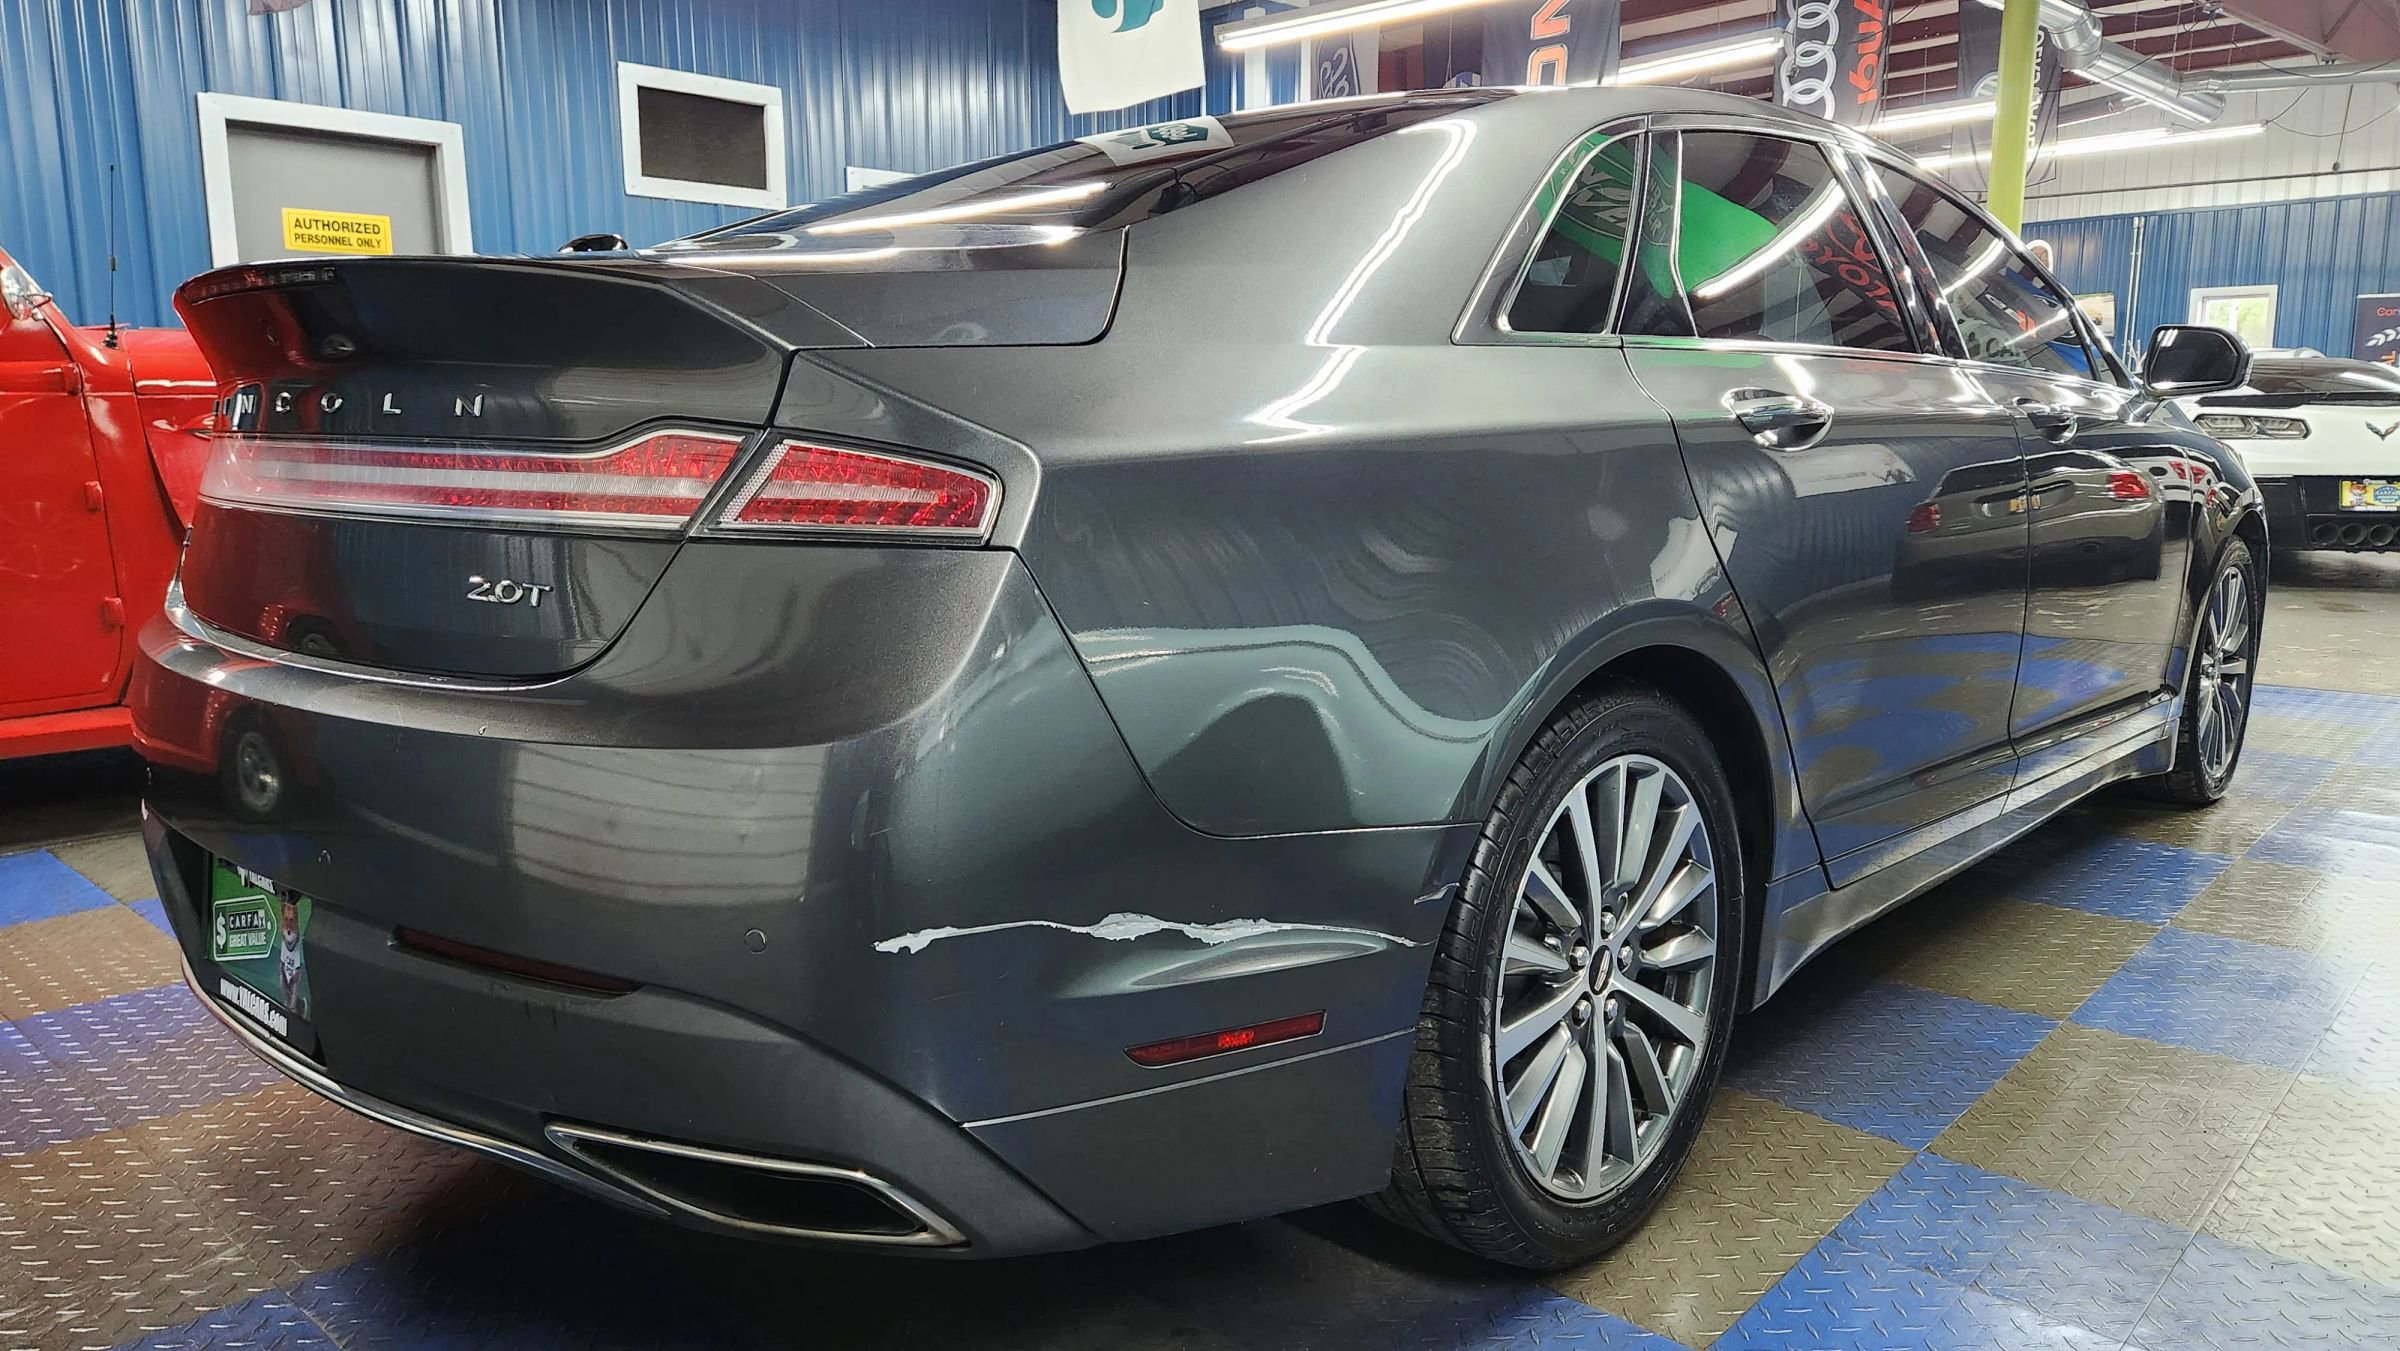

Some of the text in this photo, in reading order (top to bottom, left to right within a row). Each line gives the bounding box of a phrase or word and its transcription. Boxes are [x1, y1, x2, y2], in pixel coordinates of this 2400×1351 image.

[294, 216, 381, 235] AUTHORIZED
[294, 233, 382, 248] PERSONNEL ONLY
[229, 911, 266, 929] CARFAX
[229, 931, 267, 948] GREAT VALUE
